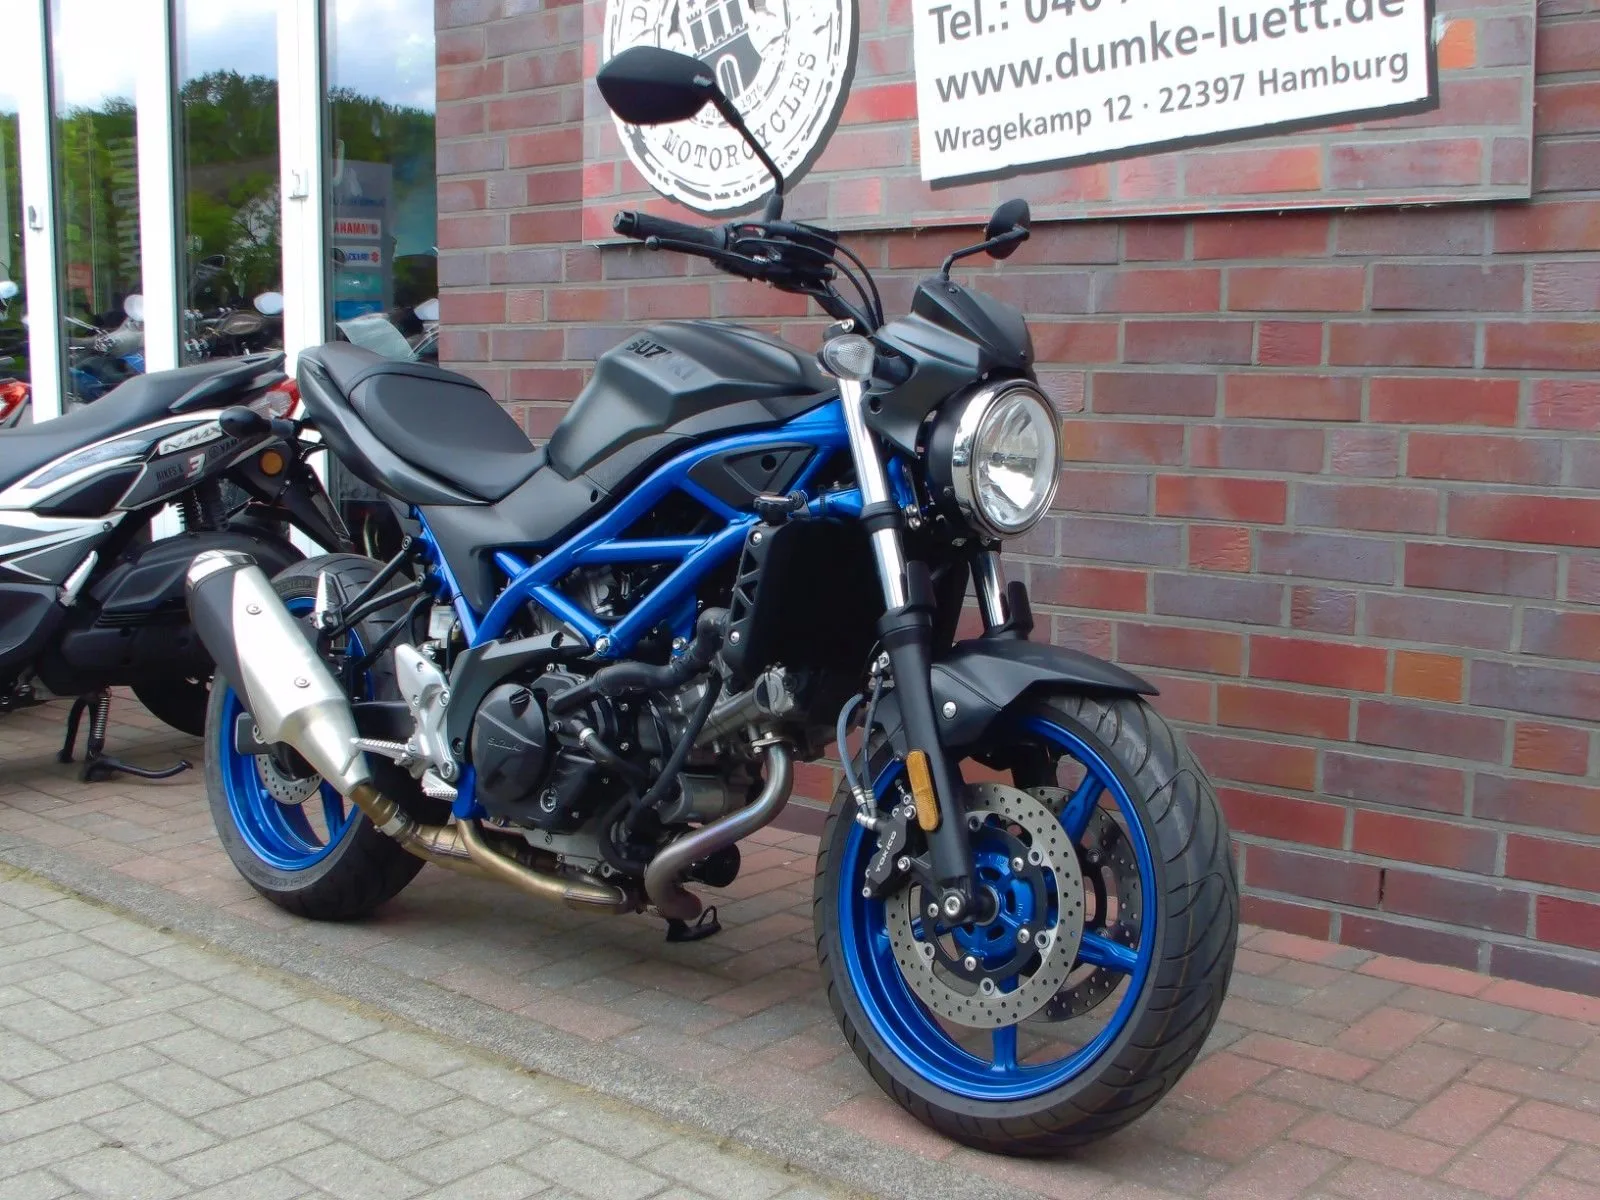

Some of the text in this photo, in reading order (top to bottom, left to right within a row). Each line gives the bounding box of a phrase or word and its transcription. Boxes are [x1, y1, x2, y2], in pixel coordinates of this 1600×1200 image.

[927, 0, 1009, 45] Tel.:
[934, 0, 1405, 103] www.dumke-luett.de
[661, 50, 817, 172] MOTORCYCLES
[934, 112, 1092, 153] Wragekamp
[1102, 94, 1133, 123] 12
[1158, 73, 1246, 114] 22397
[1257, 51, 1409, 97] Hamburg
[875, 831, 897, 872] TOKICO
